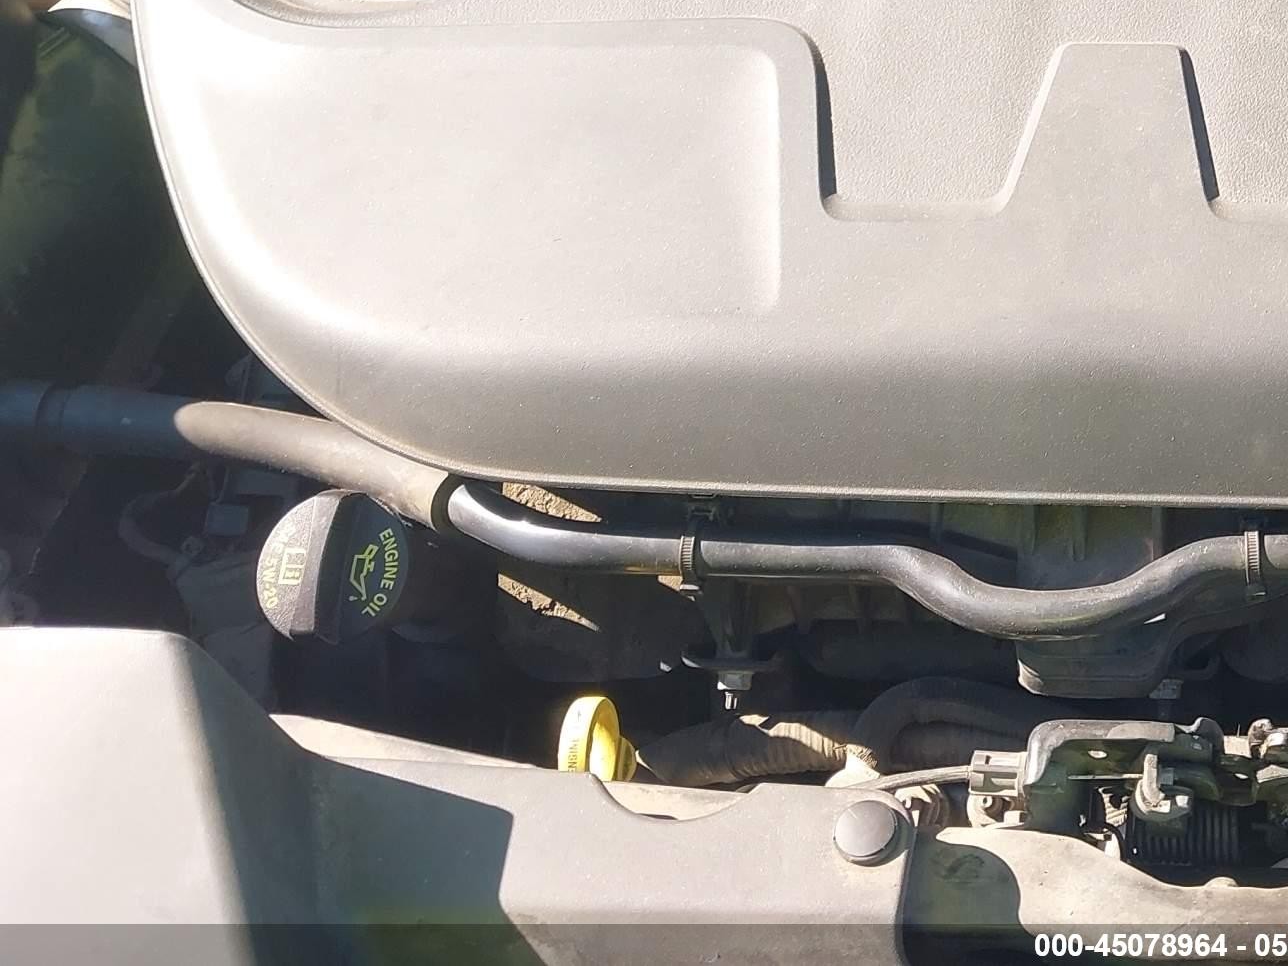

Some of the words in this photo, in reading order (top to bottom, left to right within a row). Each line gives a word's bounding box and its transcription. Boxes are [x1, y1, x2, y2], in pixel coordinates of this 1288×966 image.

[261, 556, 279, 610] 5W-20
[379, 528, 399, 590] ENGINE
[361, 593, 388, 618] OIL
